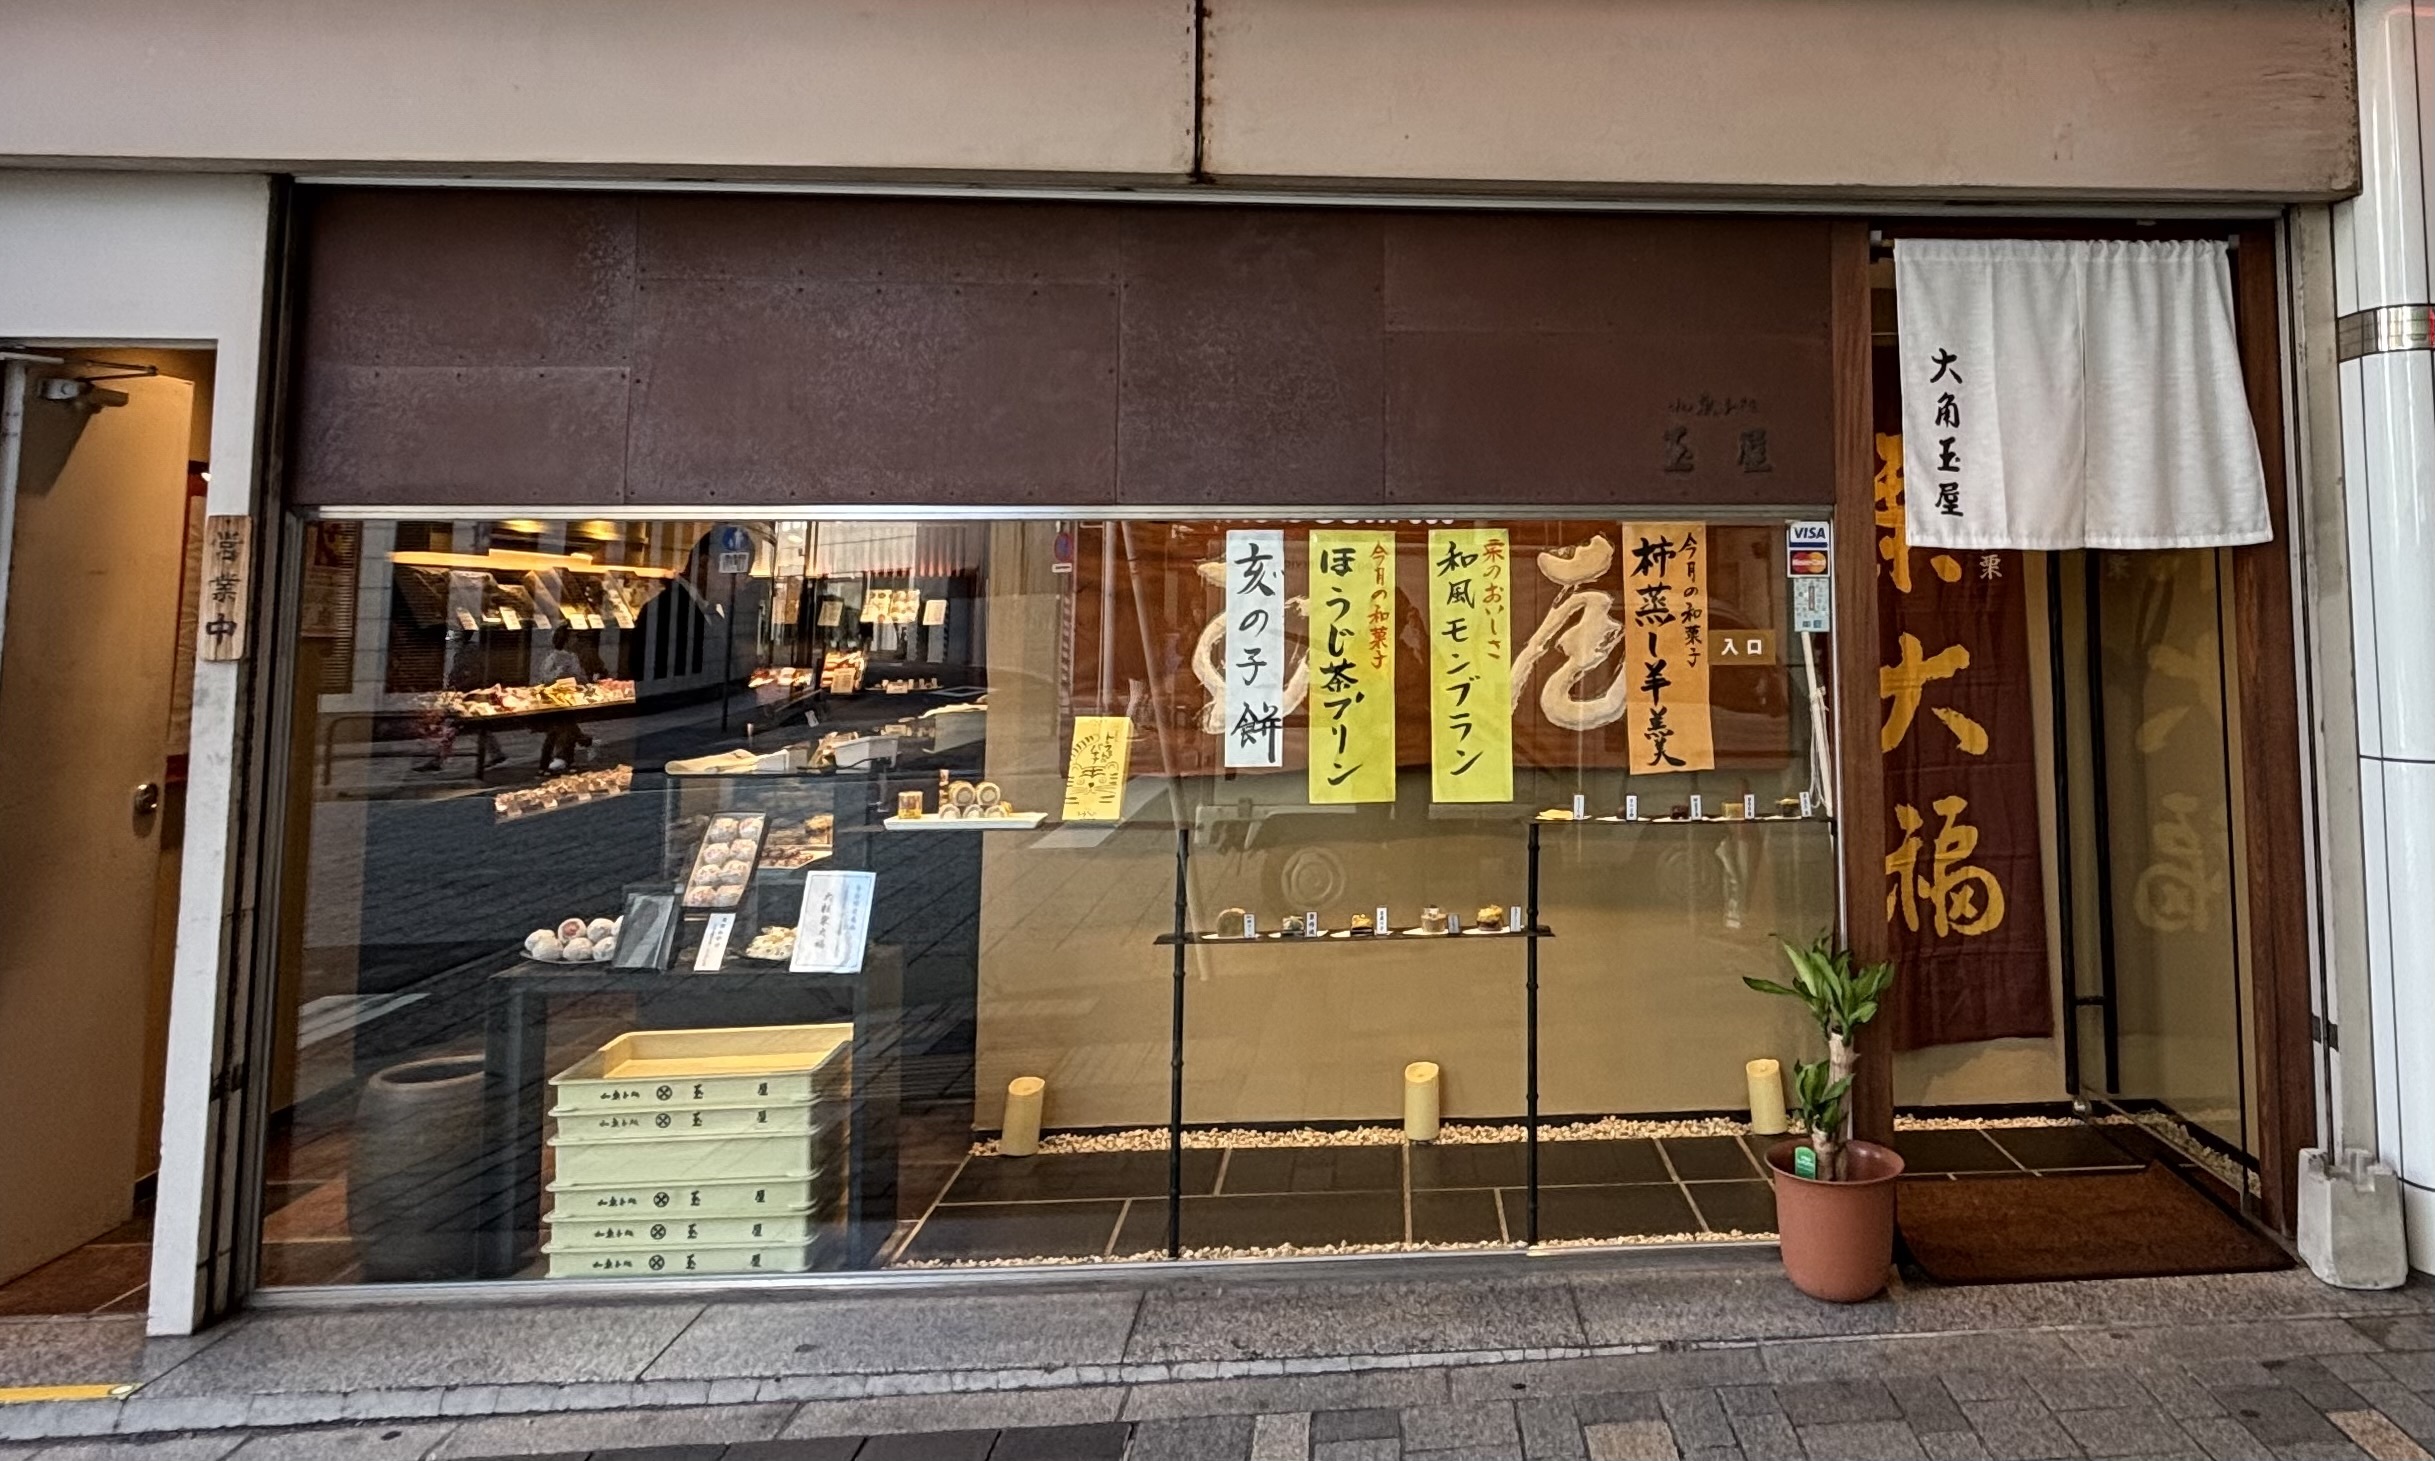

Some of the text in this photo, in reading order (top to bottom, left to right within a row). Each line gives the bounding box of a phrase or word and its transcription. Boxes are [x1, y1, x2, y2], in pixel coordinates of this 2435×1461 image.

[1930, 348, 1964, 516] 大角玉屋
[206, 531, 244, 646] 営業中
[1367, 540, 1389, 669] 今月の和菓子
[1678, 532, 1702, 668] 今月の和菓子
[1794, 527, 1826, 539] VISA
[1231, 543, 1284, 763] 亥の子餅
[1320, 548, 1365, 786] ほうじ茶プリン
[1436, 541, 1484, 775] 和風モンブラン
[1630, 535, 1687, 767] 柿蒸し羊羹
[1721, 638, 1762, 656] 入口
